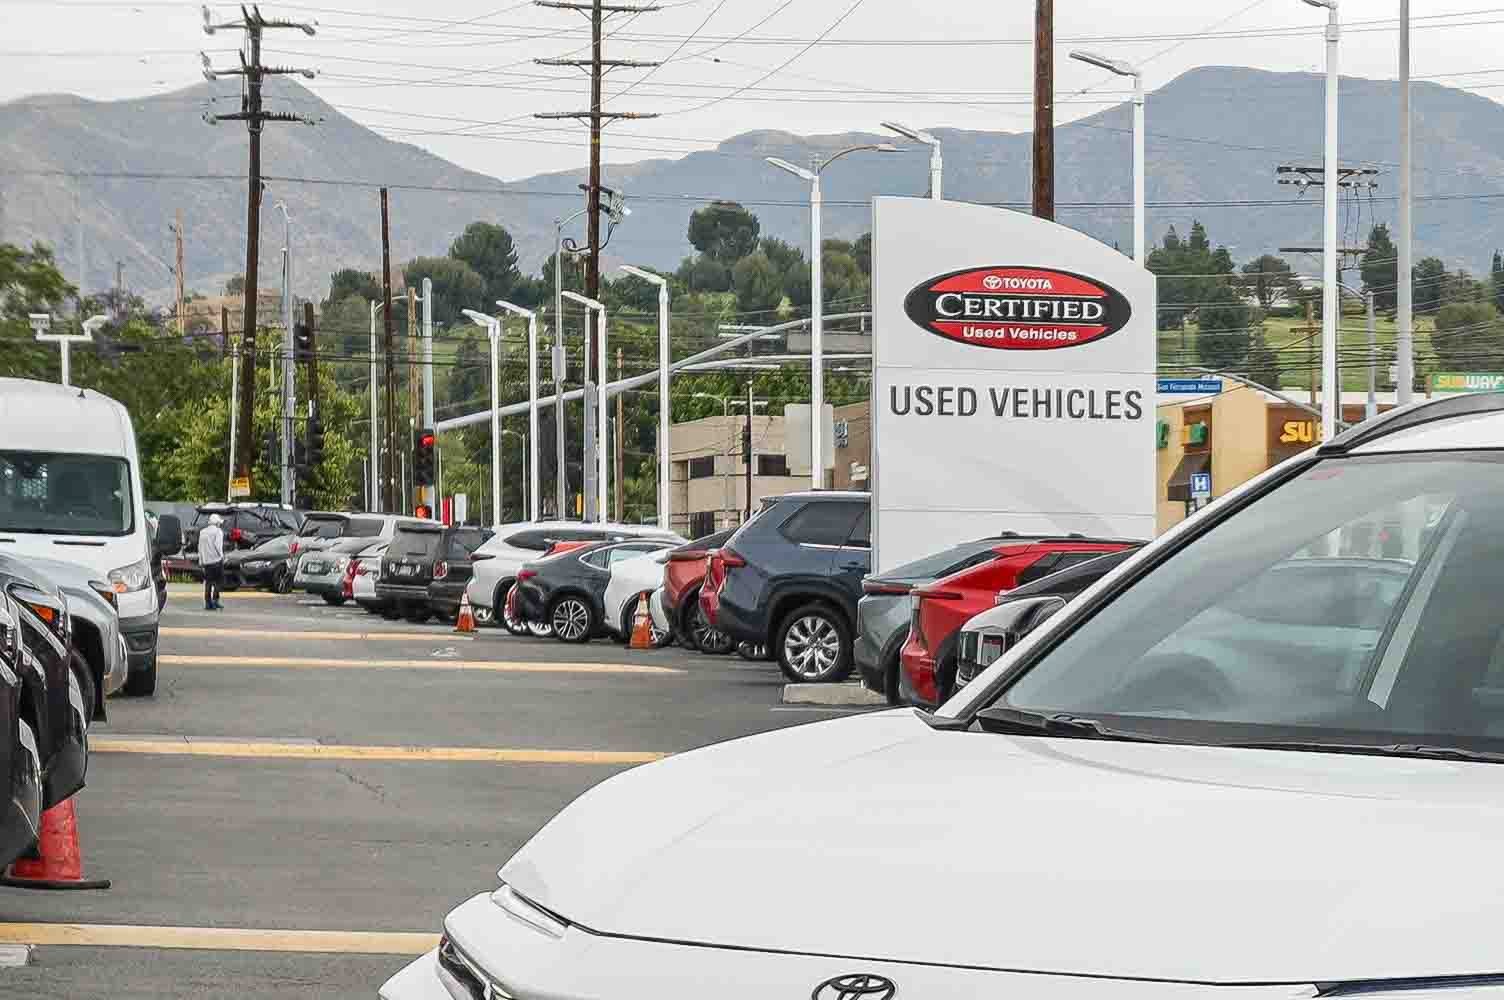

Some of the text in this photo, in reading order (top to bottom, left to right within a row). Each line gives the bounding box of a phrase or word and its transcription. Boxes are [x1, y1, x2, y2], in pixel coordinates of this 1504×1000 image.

[1003, 277, 1053, 290] TOYOTA
[935, 293, 1103, 320] CERTIFIED
[963, 326, 1077, 341] Used Vehicles
[889, 385, 1143, 420] USED VEHICLES
